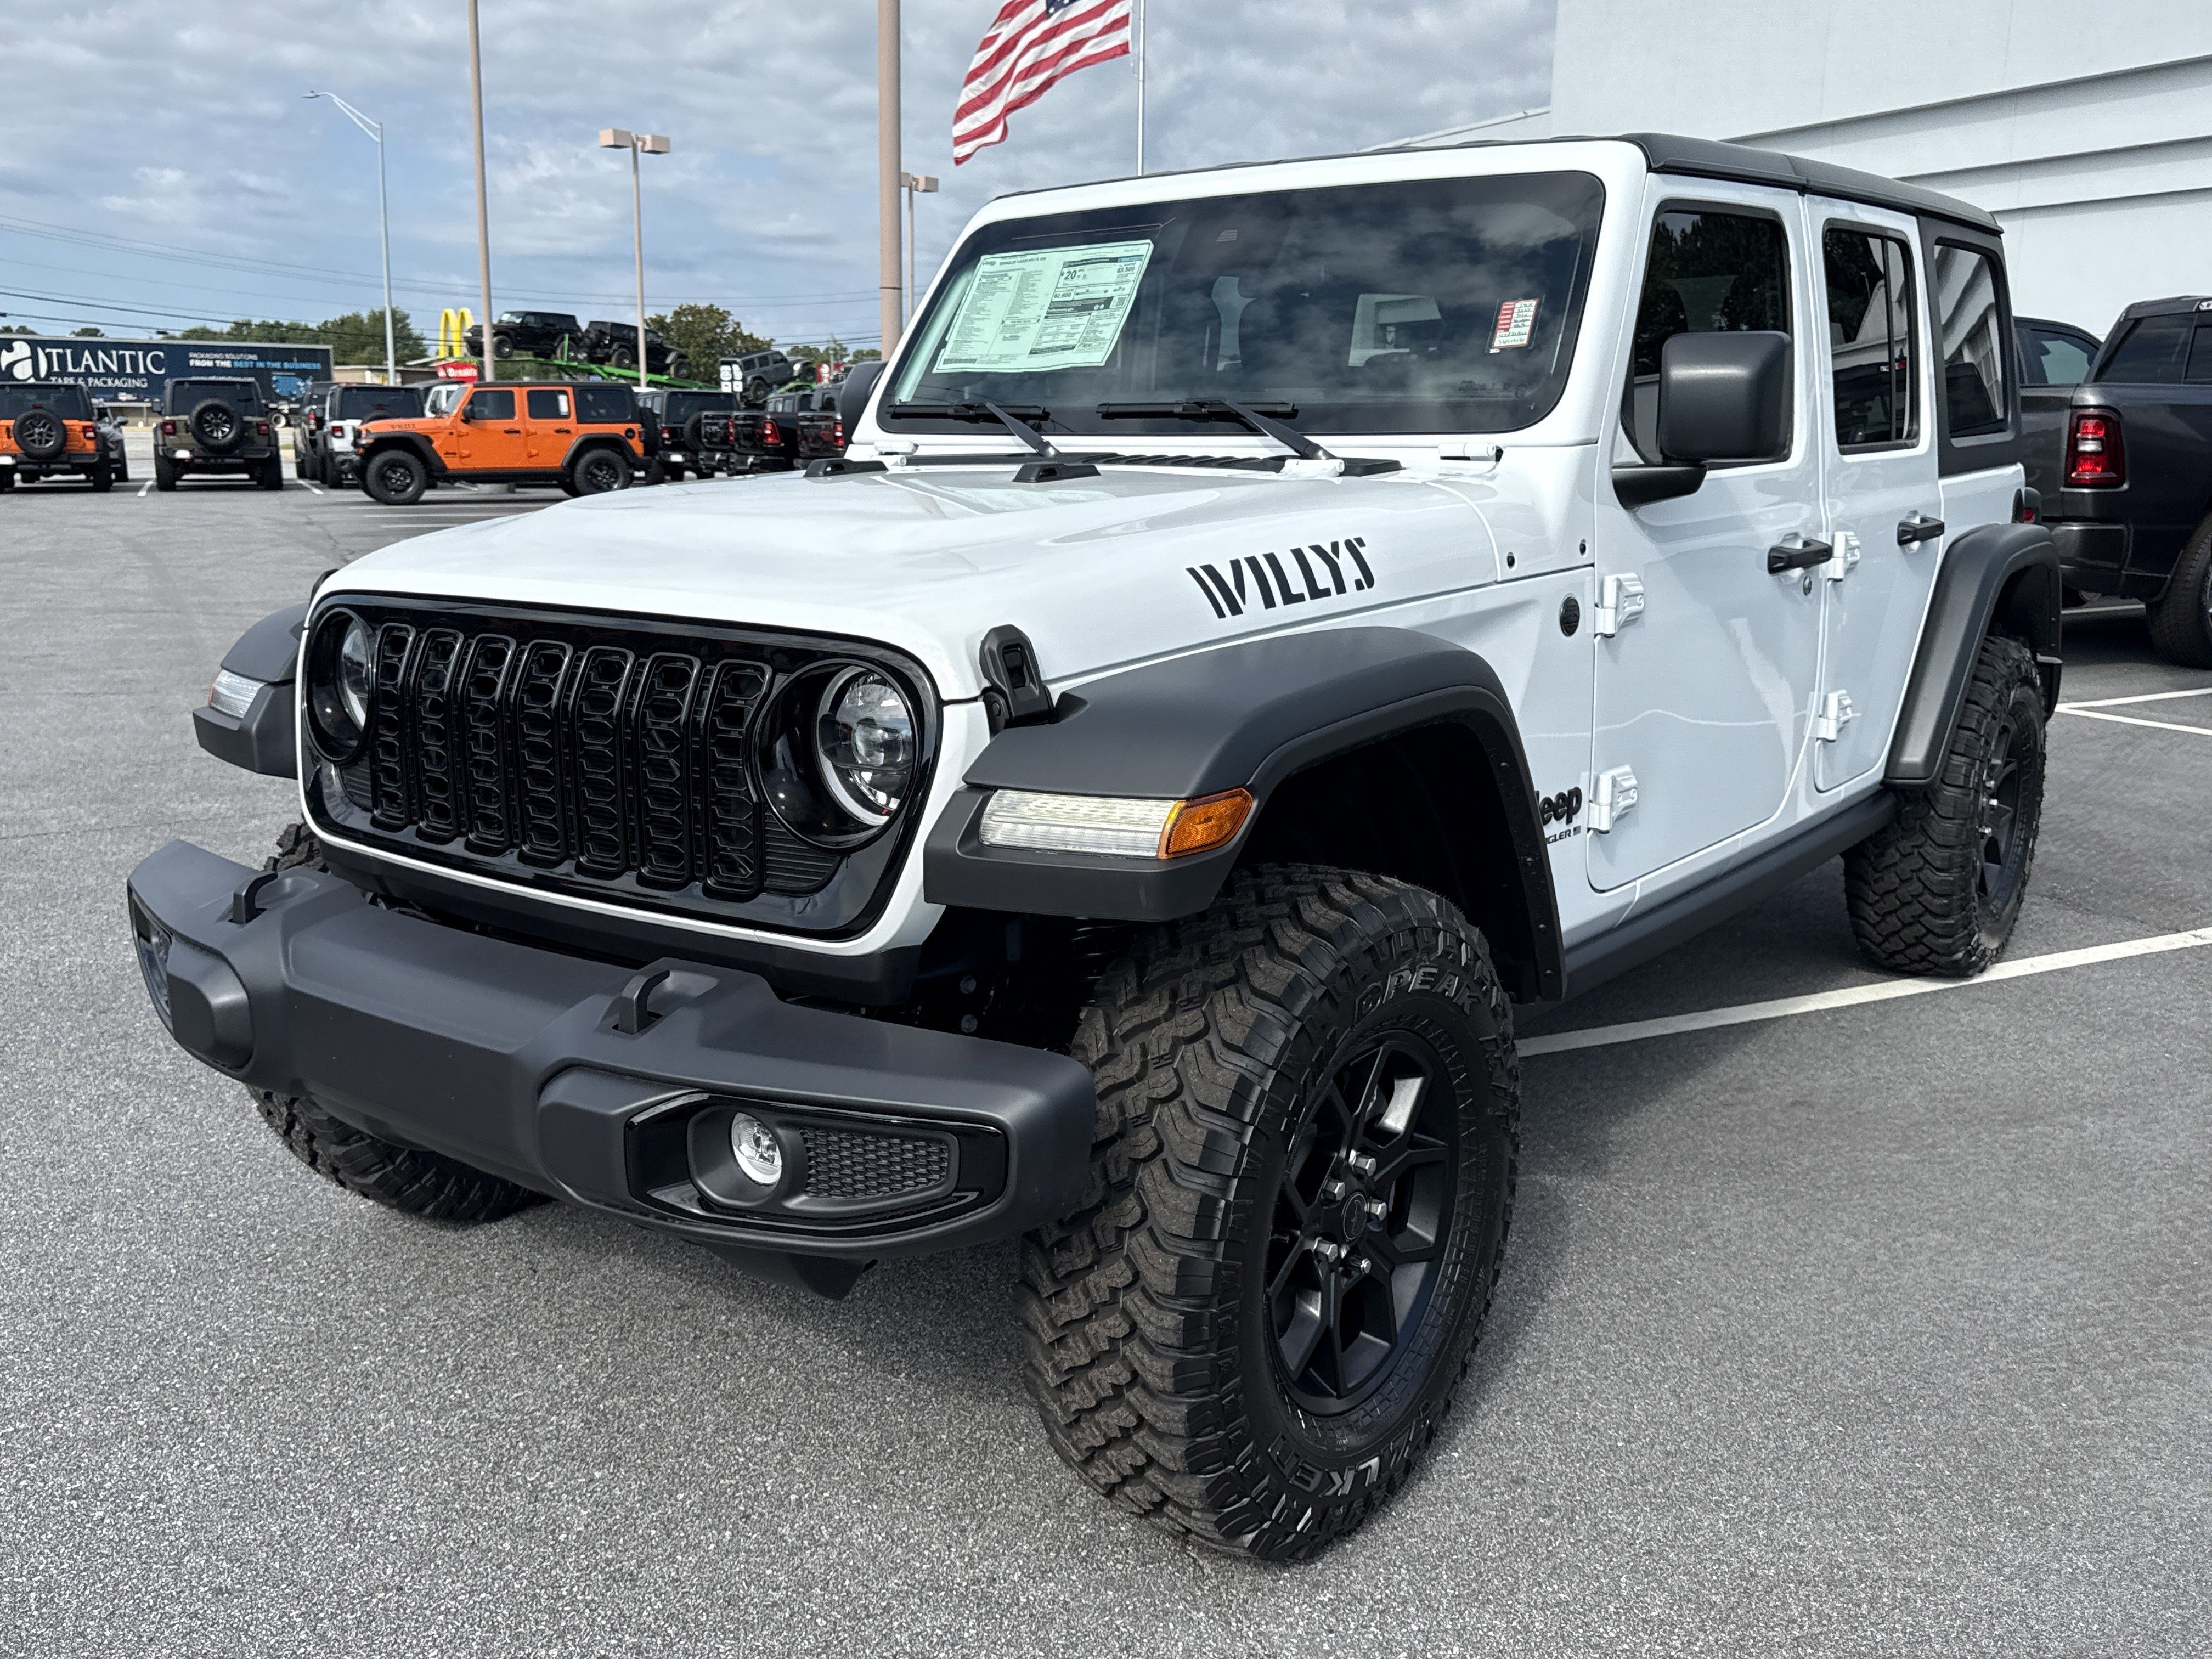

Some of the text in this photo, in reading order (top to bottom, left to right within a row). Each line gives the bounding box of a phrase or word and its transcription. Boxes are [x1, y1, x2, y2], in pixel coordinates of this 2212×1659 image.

[1064, 270, 1077, 280] 20
[87, 377, 148, 388] PACKAGING
[1185, 537, 1374, 619] WILLYS
